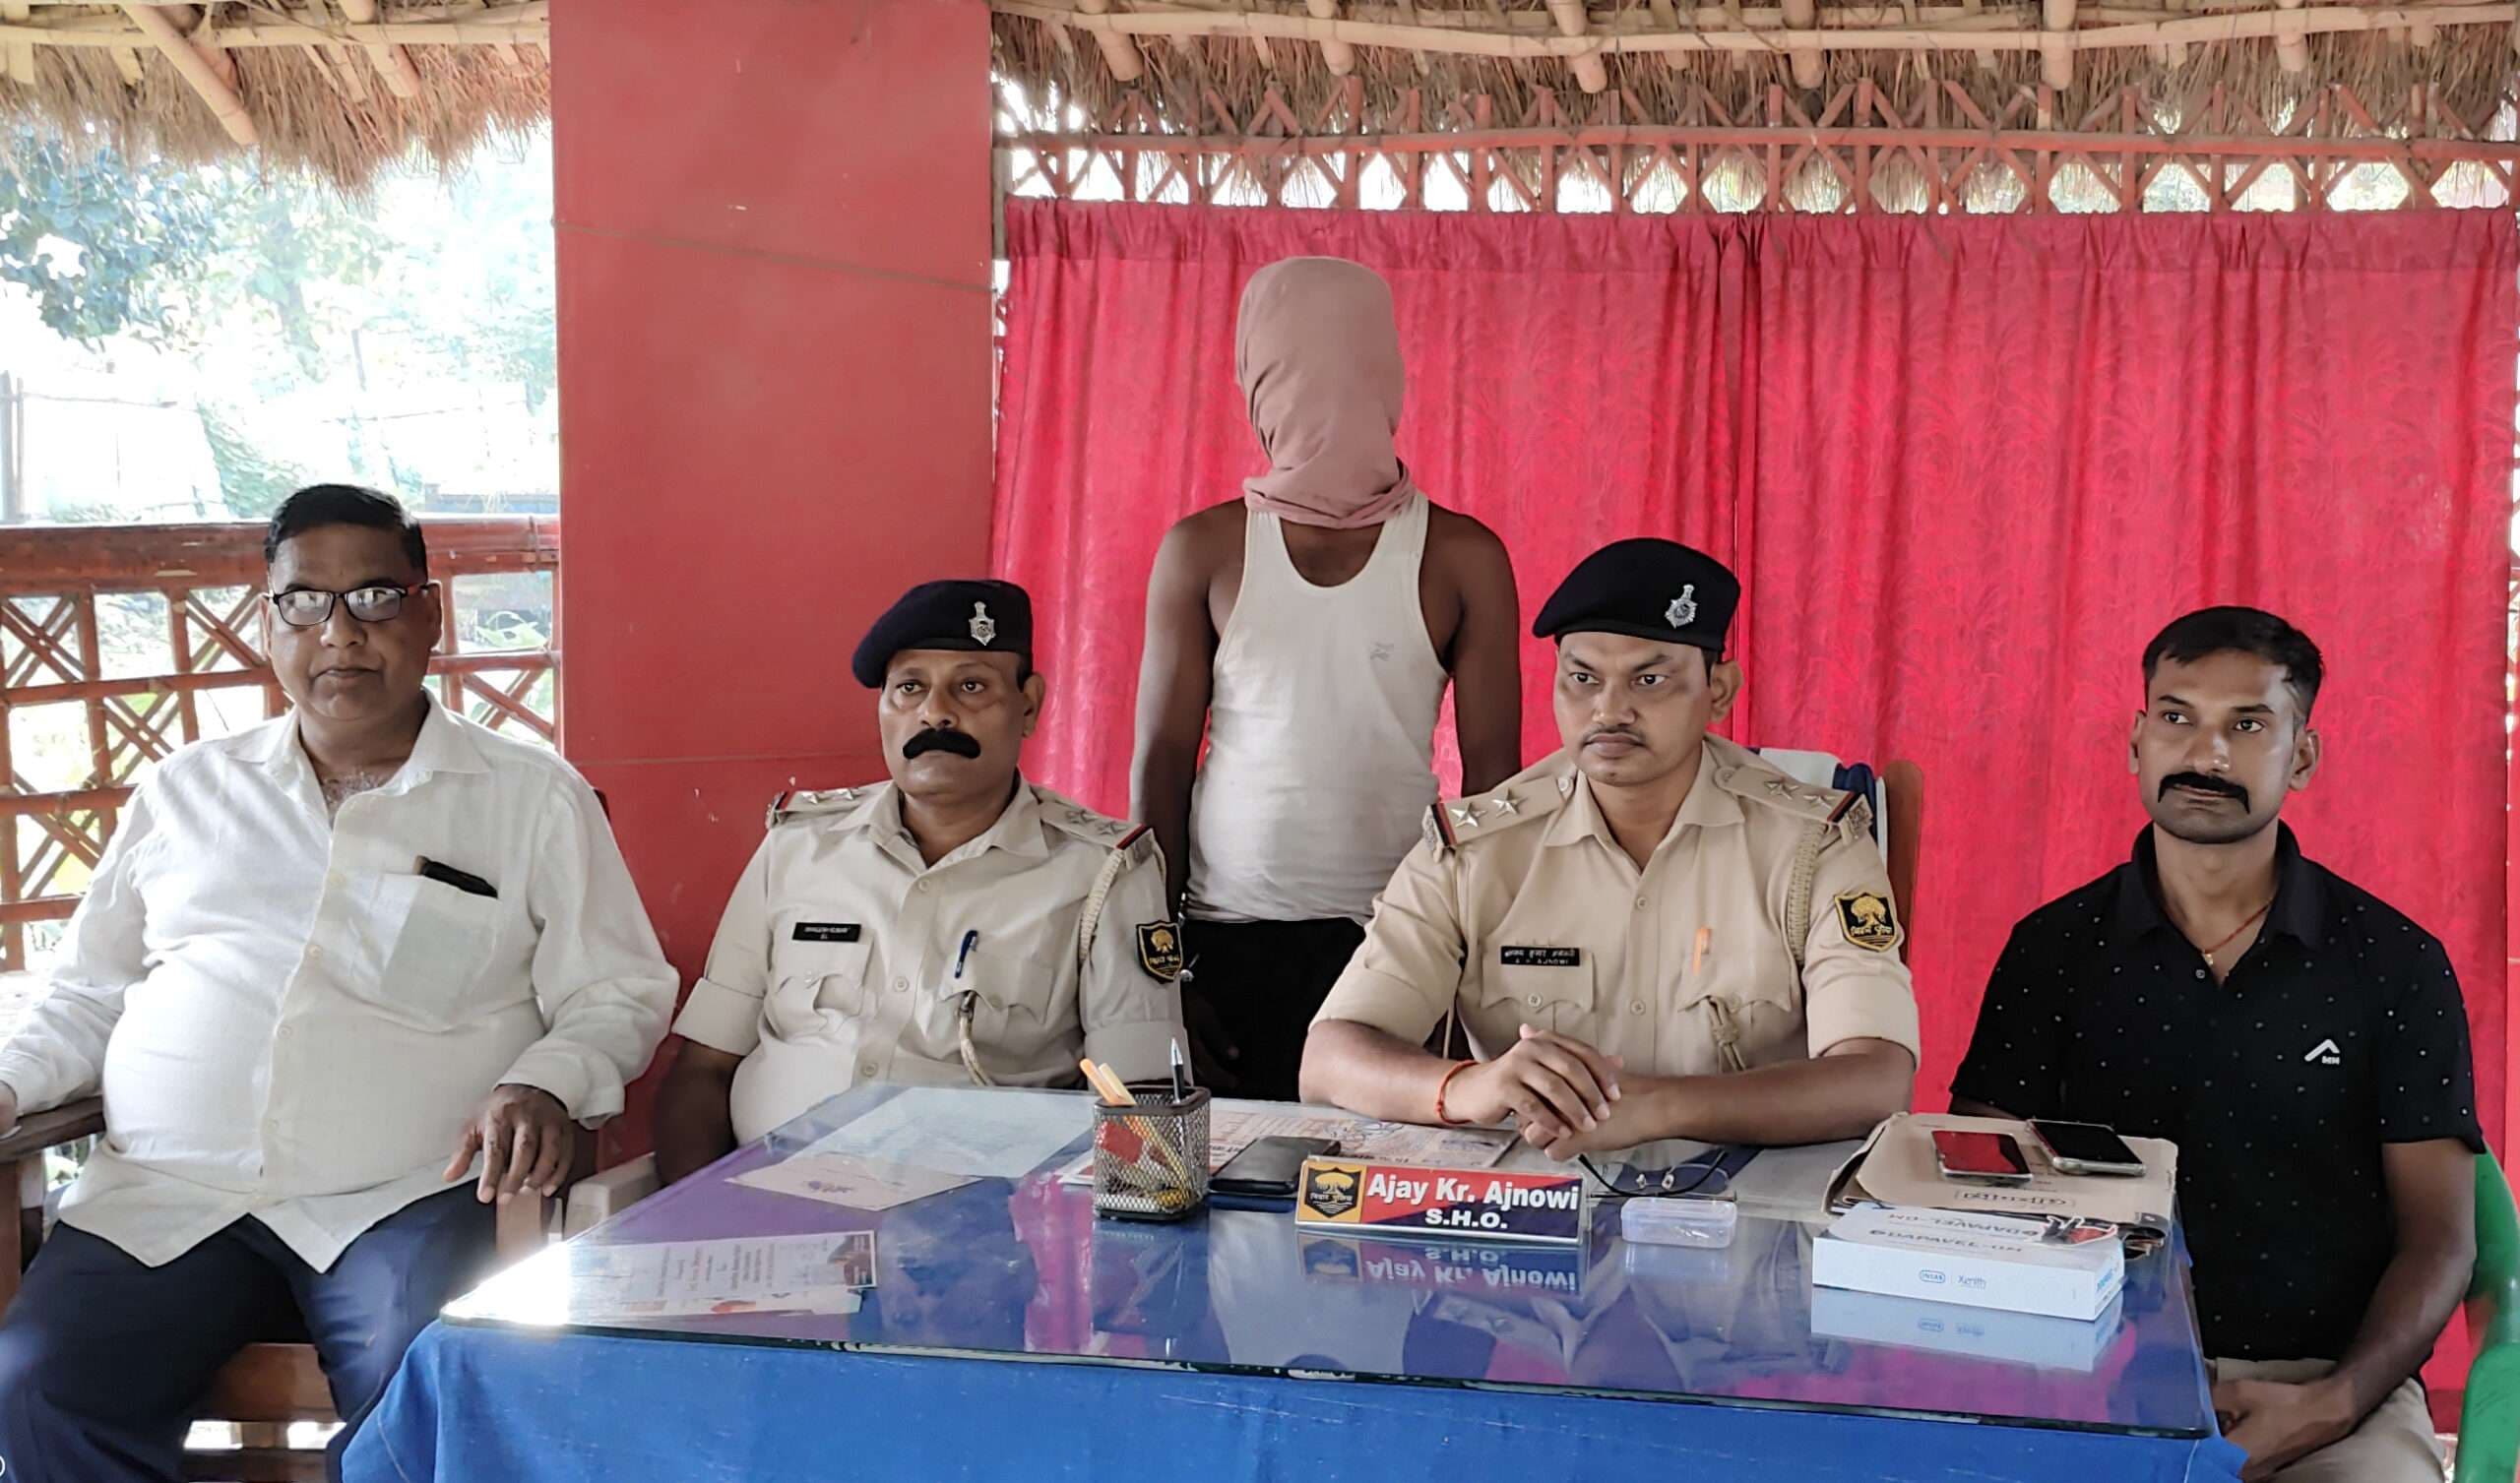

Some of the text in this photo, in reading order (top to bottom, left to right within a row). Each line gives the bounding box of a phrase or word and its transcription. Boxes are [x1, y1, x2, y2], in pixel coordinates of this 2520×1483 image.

[1367, 1173, 1579, 1211] Ajay Kr. Ajnowi
[1424, 1207, 1509, 1229] S.H.O.
